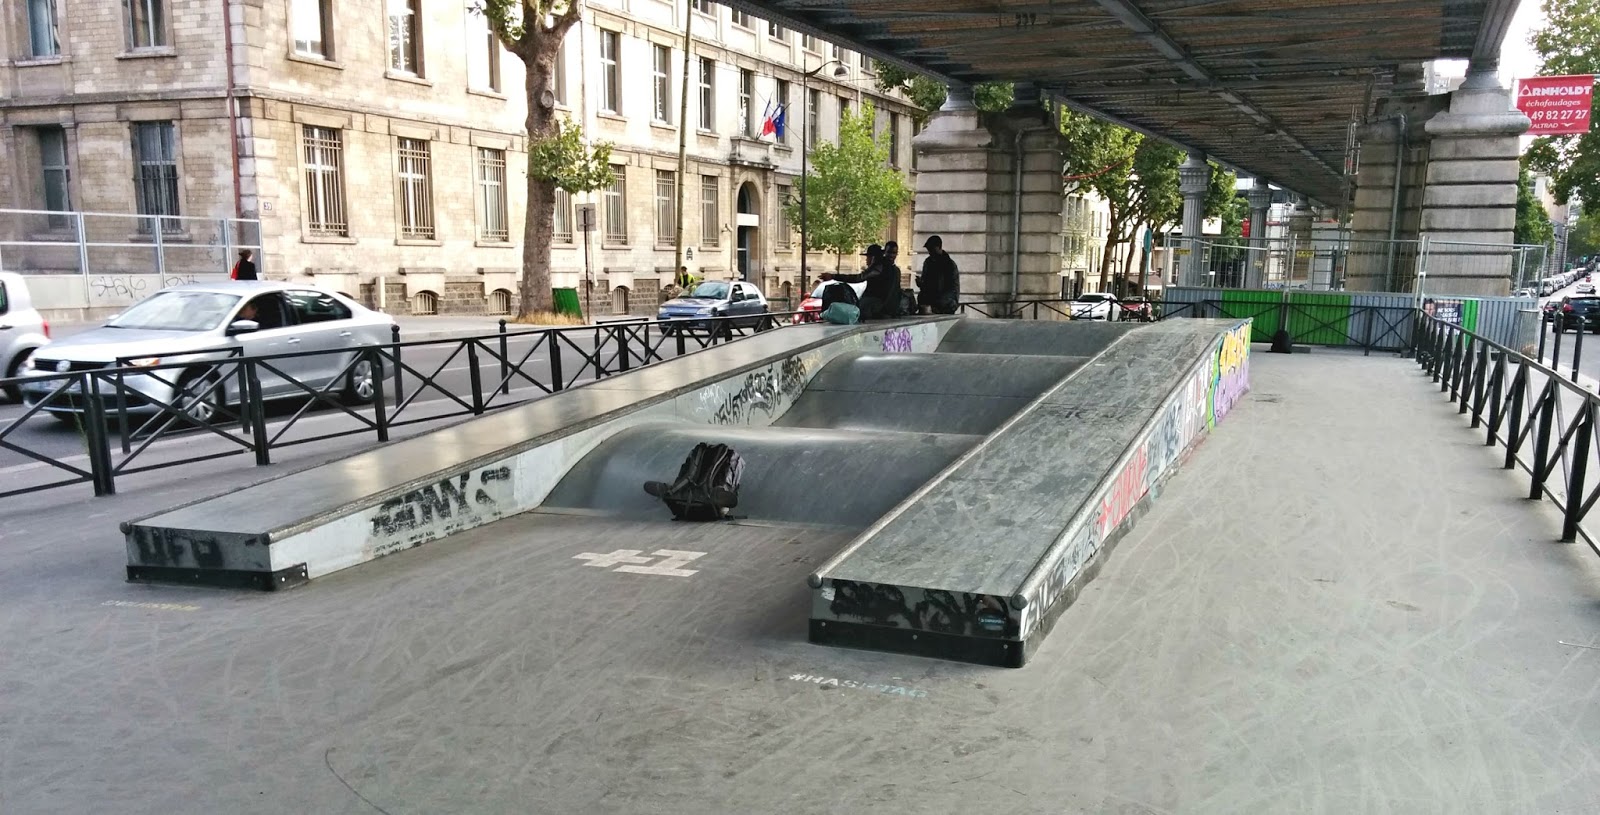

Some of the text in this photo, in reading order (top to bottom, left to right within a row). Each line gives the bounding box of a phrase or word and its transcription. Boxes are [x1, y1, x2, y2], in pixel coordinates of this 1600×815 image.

[1518, 84, 1592, 97] ARNHOLDT
[1525, 99, 1580, 108] échafaudages
[1531, 111, 1544, 120] 49
[1546, 110, 1559, 120] 82
[1560, 110, 1573, 120] 27
[1574, 109, 1588, 119] 27
